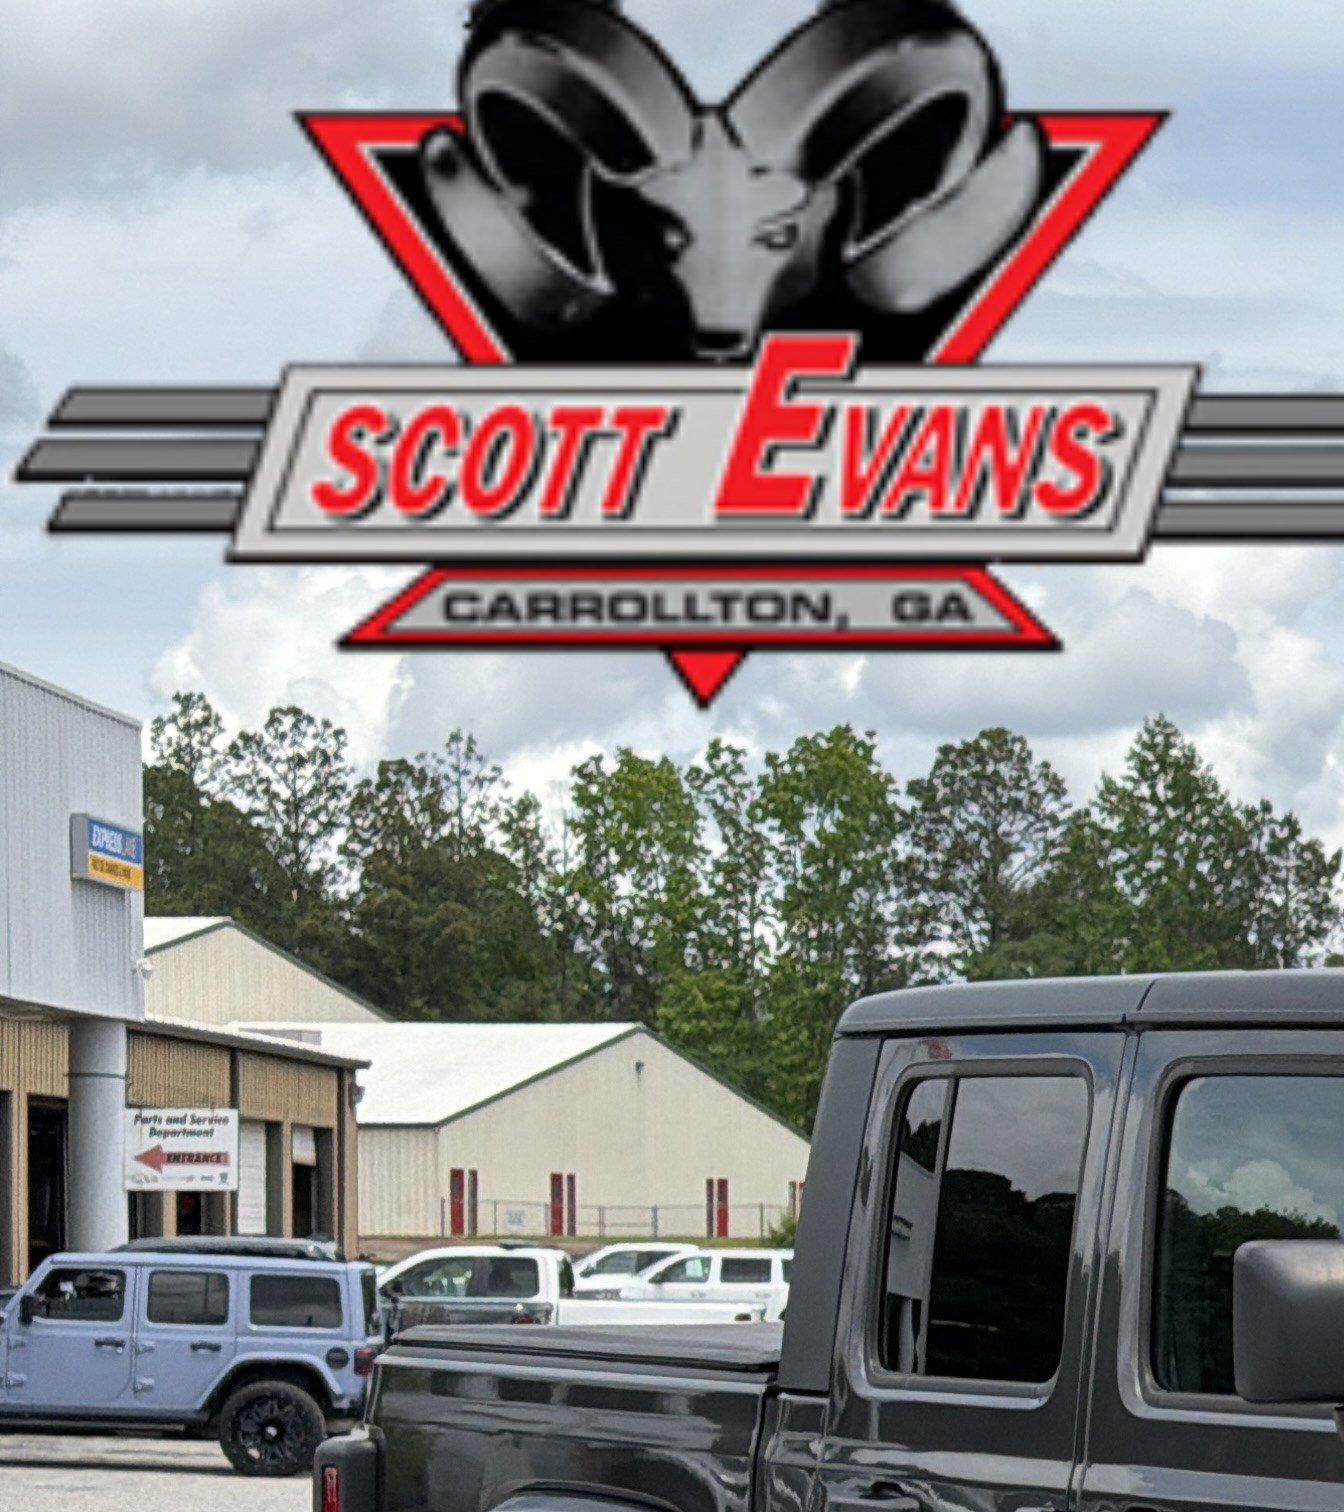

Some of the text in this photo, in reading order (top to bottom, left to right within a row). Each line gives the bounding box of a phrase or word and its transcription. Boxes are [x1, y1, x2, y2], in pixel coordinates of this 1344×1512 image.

[134, 1113, 229, 1126] Parts and Service
[149, 1126, 214, 1139] Department
[165, 1152, 222, 1164] ENTRANCE
